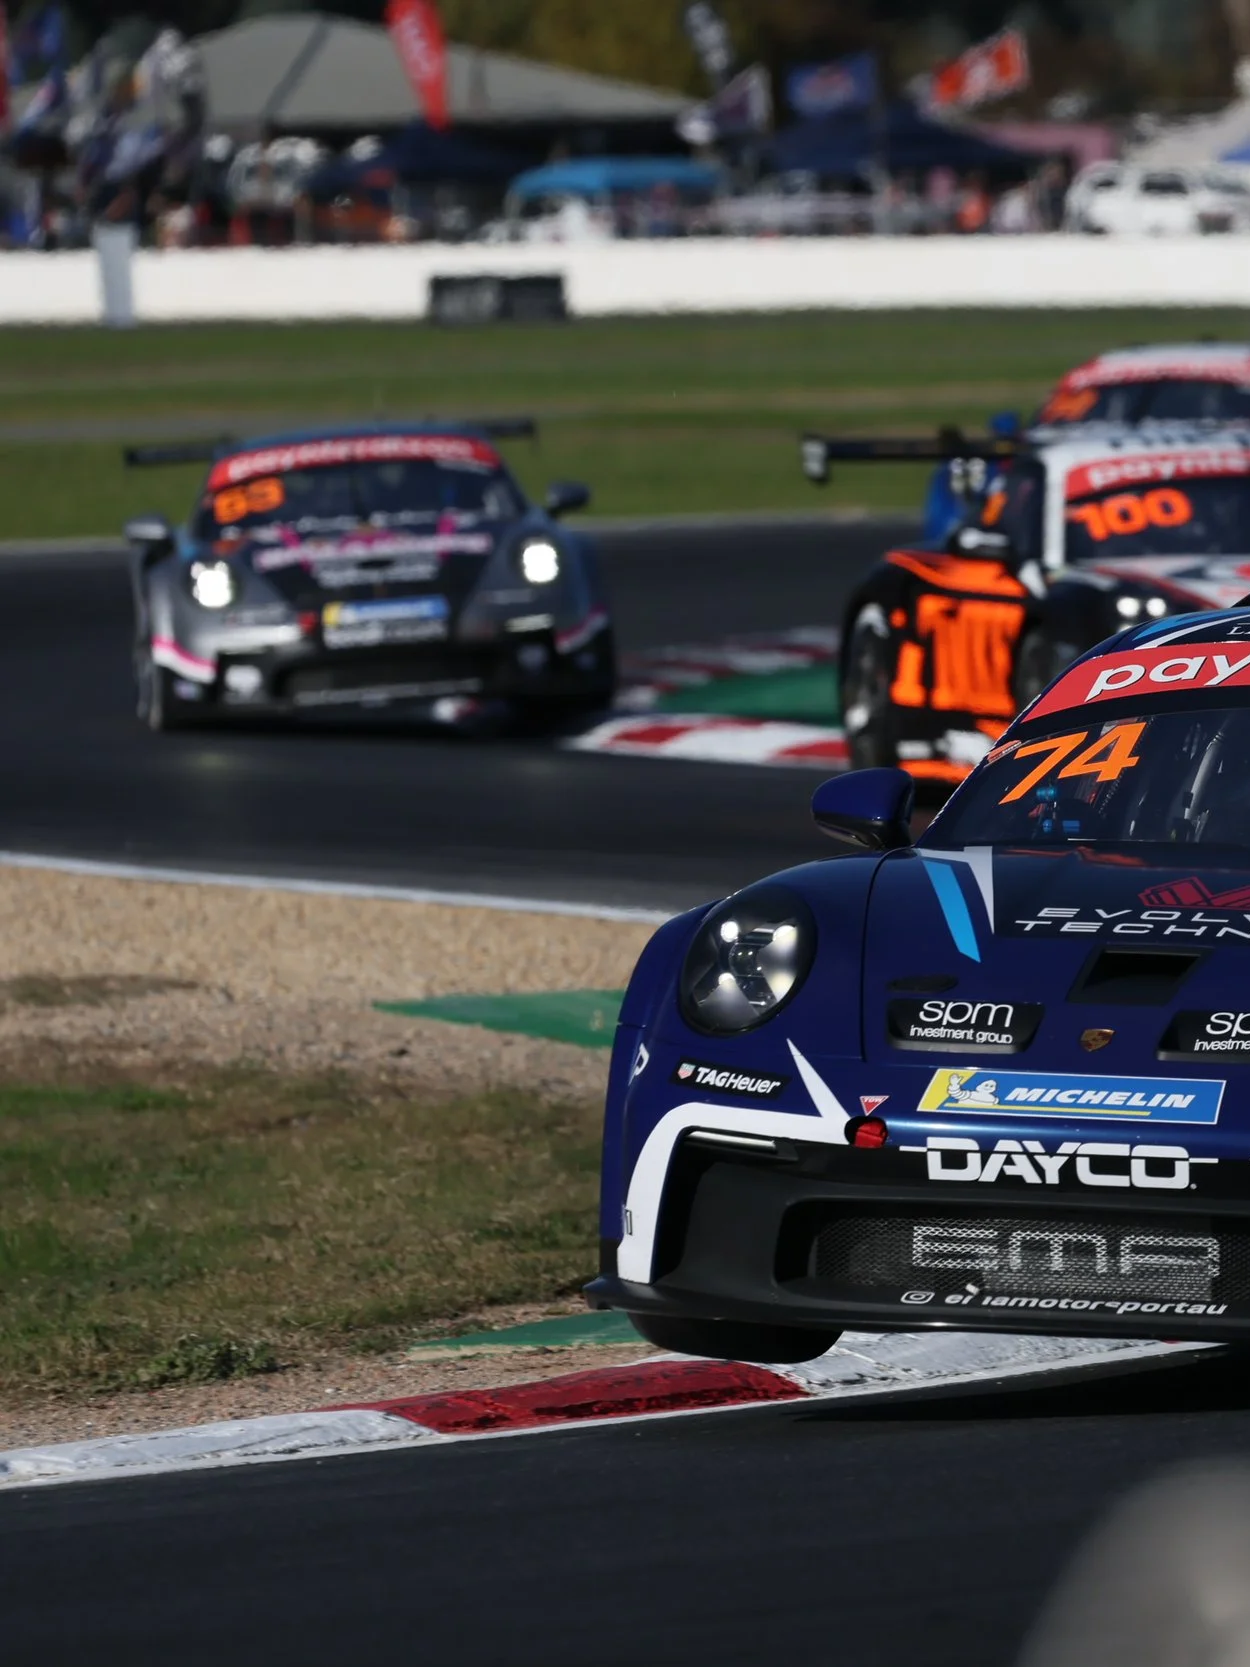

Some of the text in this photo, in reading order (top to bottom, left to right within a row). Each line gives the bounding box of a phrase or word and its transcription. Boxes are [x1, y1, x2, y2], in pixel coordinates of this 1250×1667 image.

[1068, 487, 1194, 541] 100
[998, 722, 1147, 805] 74
[919, 1000, 1014, 1029] spm
[910, 1025, 1013, 1046] investment group
[1004, 1087, 1196, 1109] MICHELIN
[927, 1136, 1190, 1189] DAYCO
